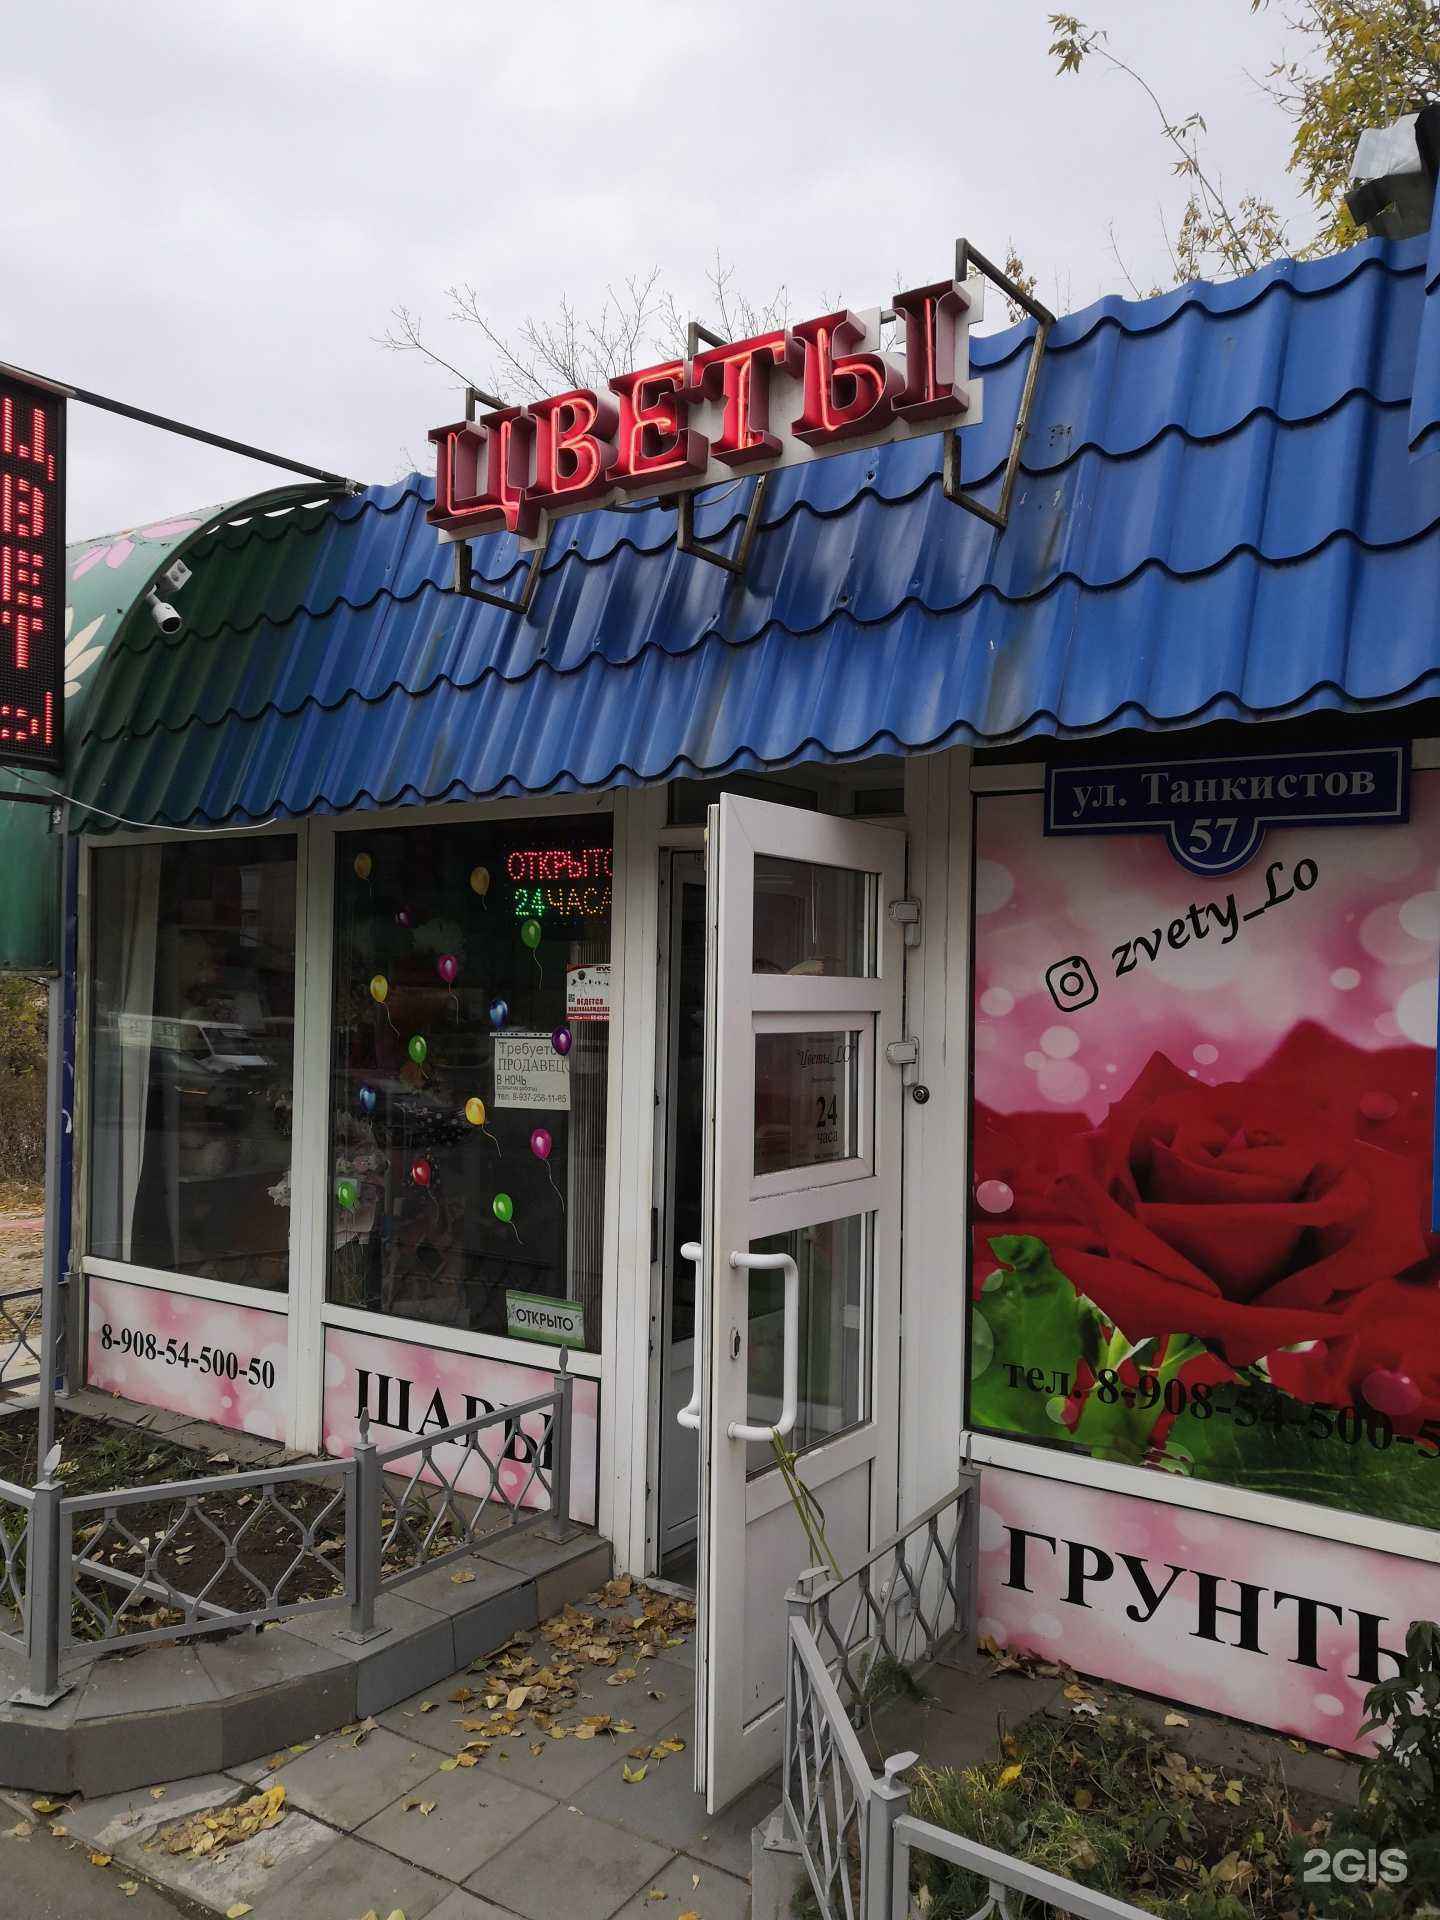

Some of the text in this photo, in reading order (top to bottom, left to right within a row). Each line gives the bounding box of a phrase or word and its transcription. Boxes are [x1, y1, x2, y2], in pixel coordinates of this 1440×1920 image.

[426, 279, 970, 537] ЦВЕТЫ
[1072, 769, 1376, 818] ул. Танкистов
[1187, 817, 1239, 855] 57
[1111, 858, 1319, 977] zvety_Lo
[816, 1094, 838, 1128] 24
[516, 1308, 574, 1331] ОТКРЫТО
[100, 1322, 276, 1390] 8-908-54-500-50
[1002, 1362, 1083, 1397] тел.
